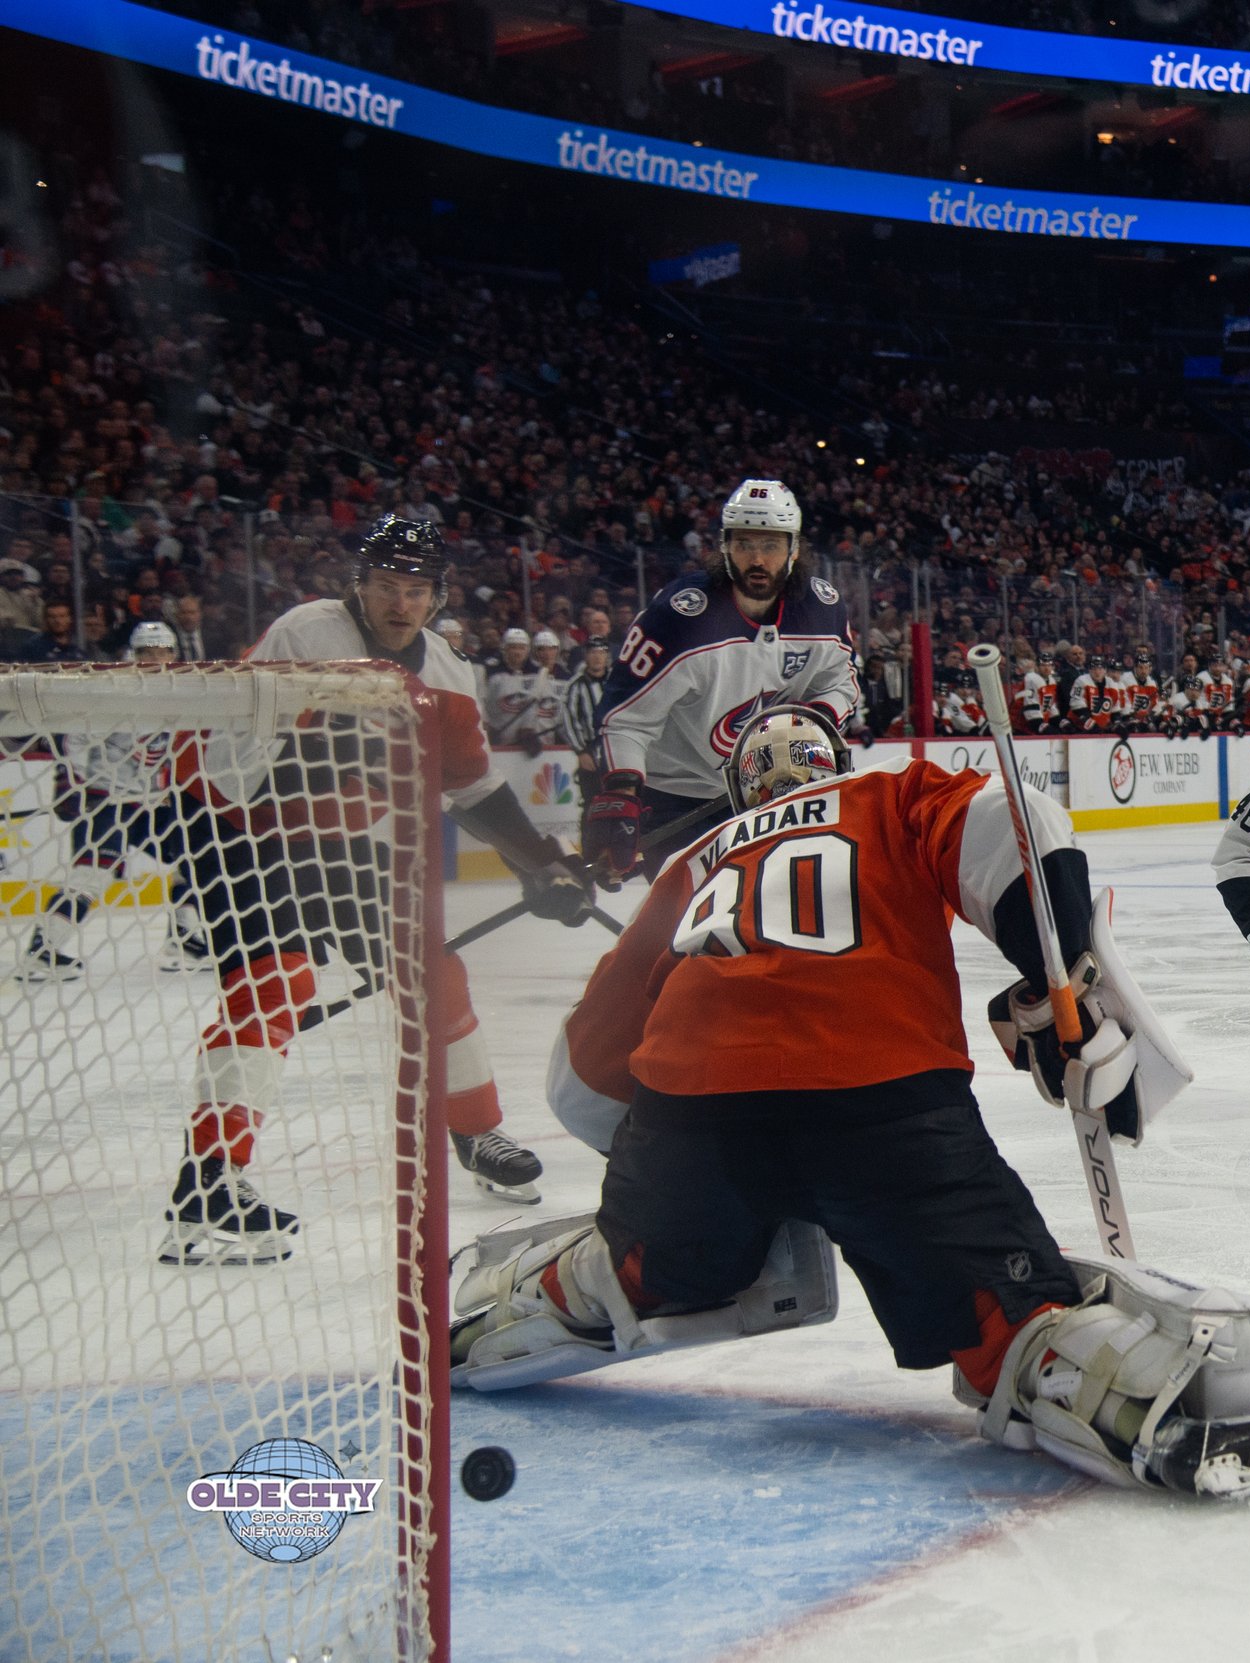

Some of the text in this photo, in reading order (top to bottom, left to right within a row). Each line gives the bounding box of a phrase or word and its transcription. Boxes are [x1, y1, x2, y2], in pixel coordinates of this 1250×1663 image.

[772, 2, 982, 66] ticketmaster
[196, 35, 404, 129] ticketmaster
[558, 130, 759, 200] ticketmaster
[928, 190, 1138, 240] ticketmaster
[749, 488, 768, 498] 86
[406, 529, 418, 542] 6
[618, 625, 664, 678] 86
[786, 655, 808, 674] 25
[1139, 754, 1159, 777] F.W.
[1164, 753, 1199, 776] WEBB
[1153, 780, 1186, 793] COMPANY
[699, 798, 827, 875] VLADAR
[671, 830, 863, 958] 80
